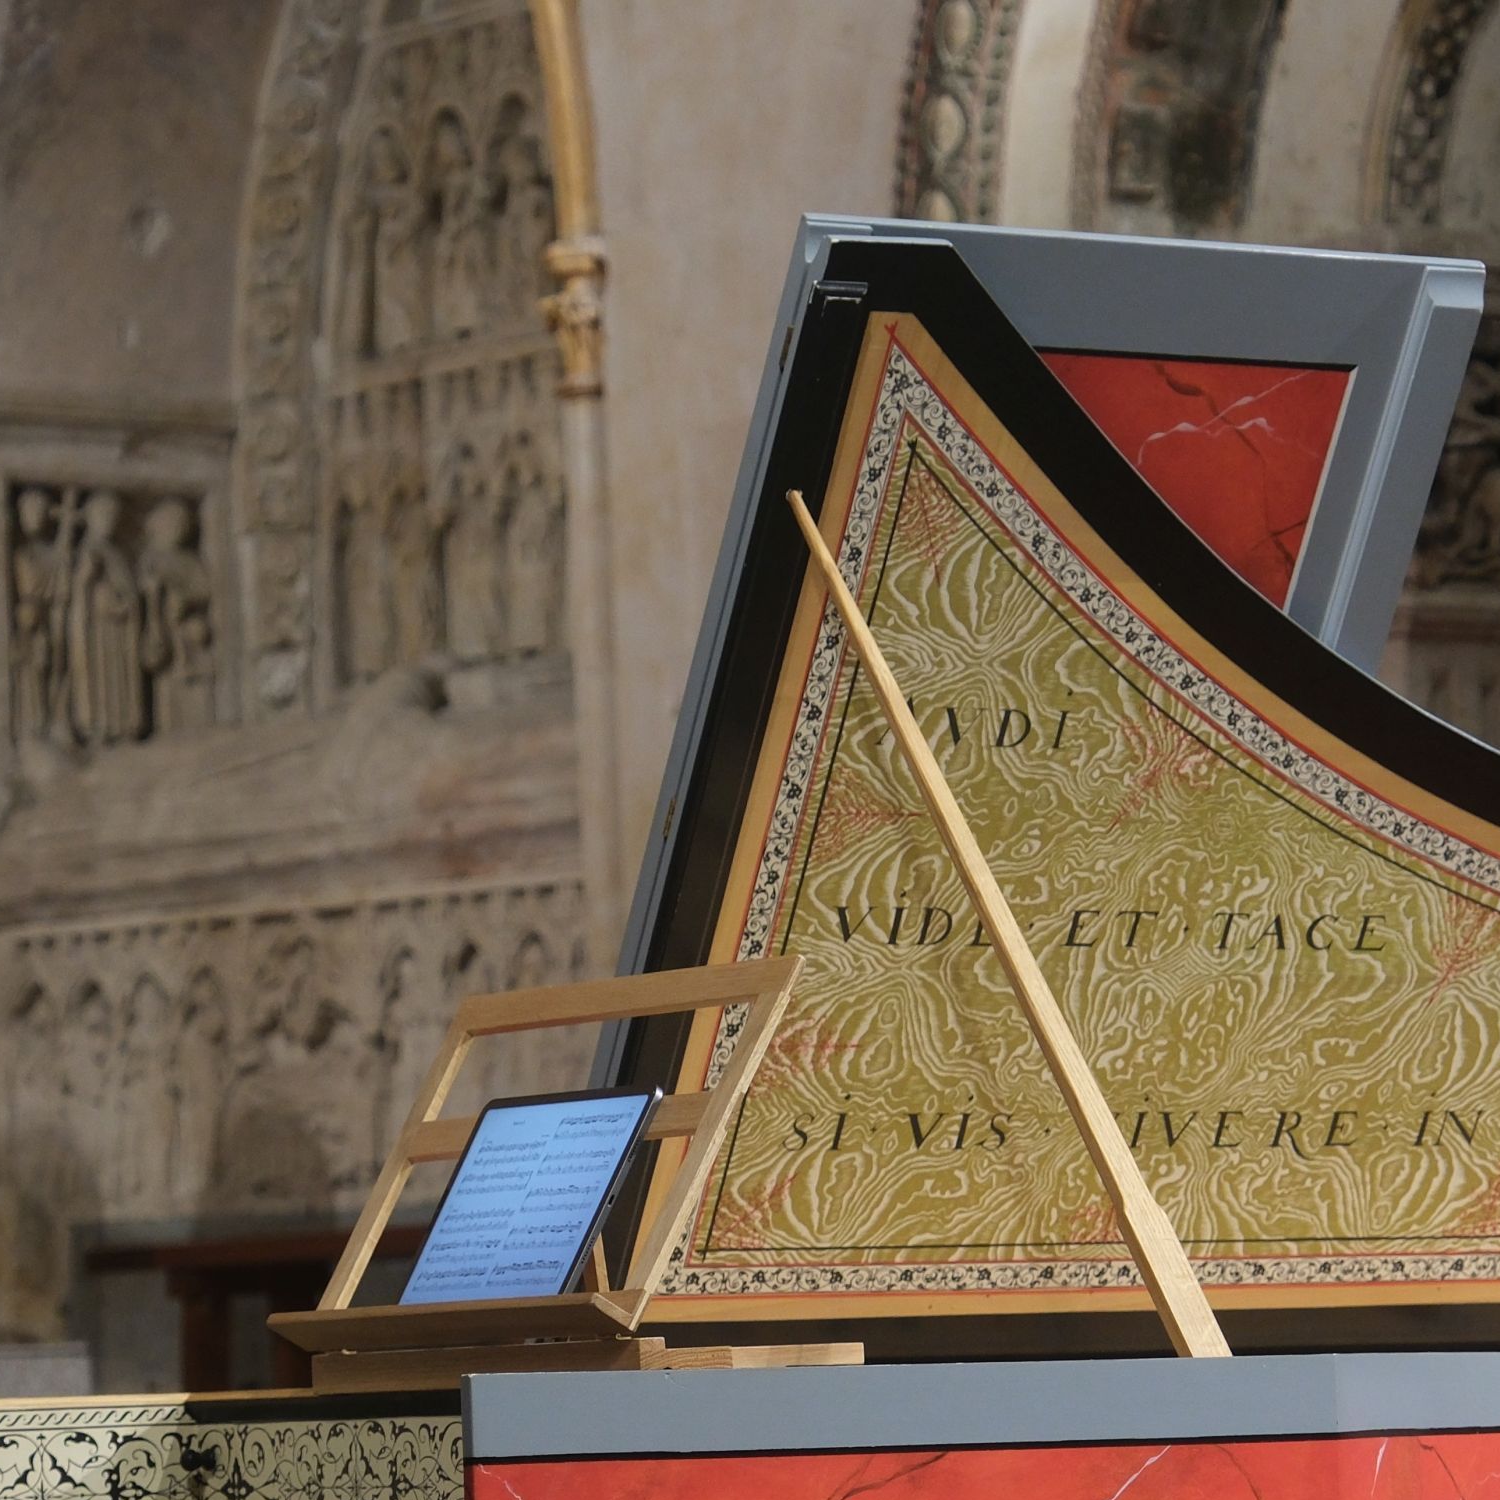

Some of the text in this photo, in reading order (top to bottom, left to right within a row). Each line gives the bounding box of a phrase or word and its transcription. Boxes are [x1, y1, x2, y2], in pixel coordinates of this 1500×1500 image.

[1060, 909, 1160, 948] ET
[1213, 912, 1387, 951] TACE
[780, 1092, 848, 1151] SI
[907, 1093, 1015, 1151] VIS
[1112, 1097, 1359, 1161] IVERE
[1413, 1091, 1484, 1147] IN
